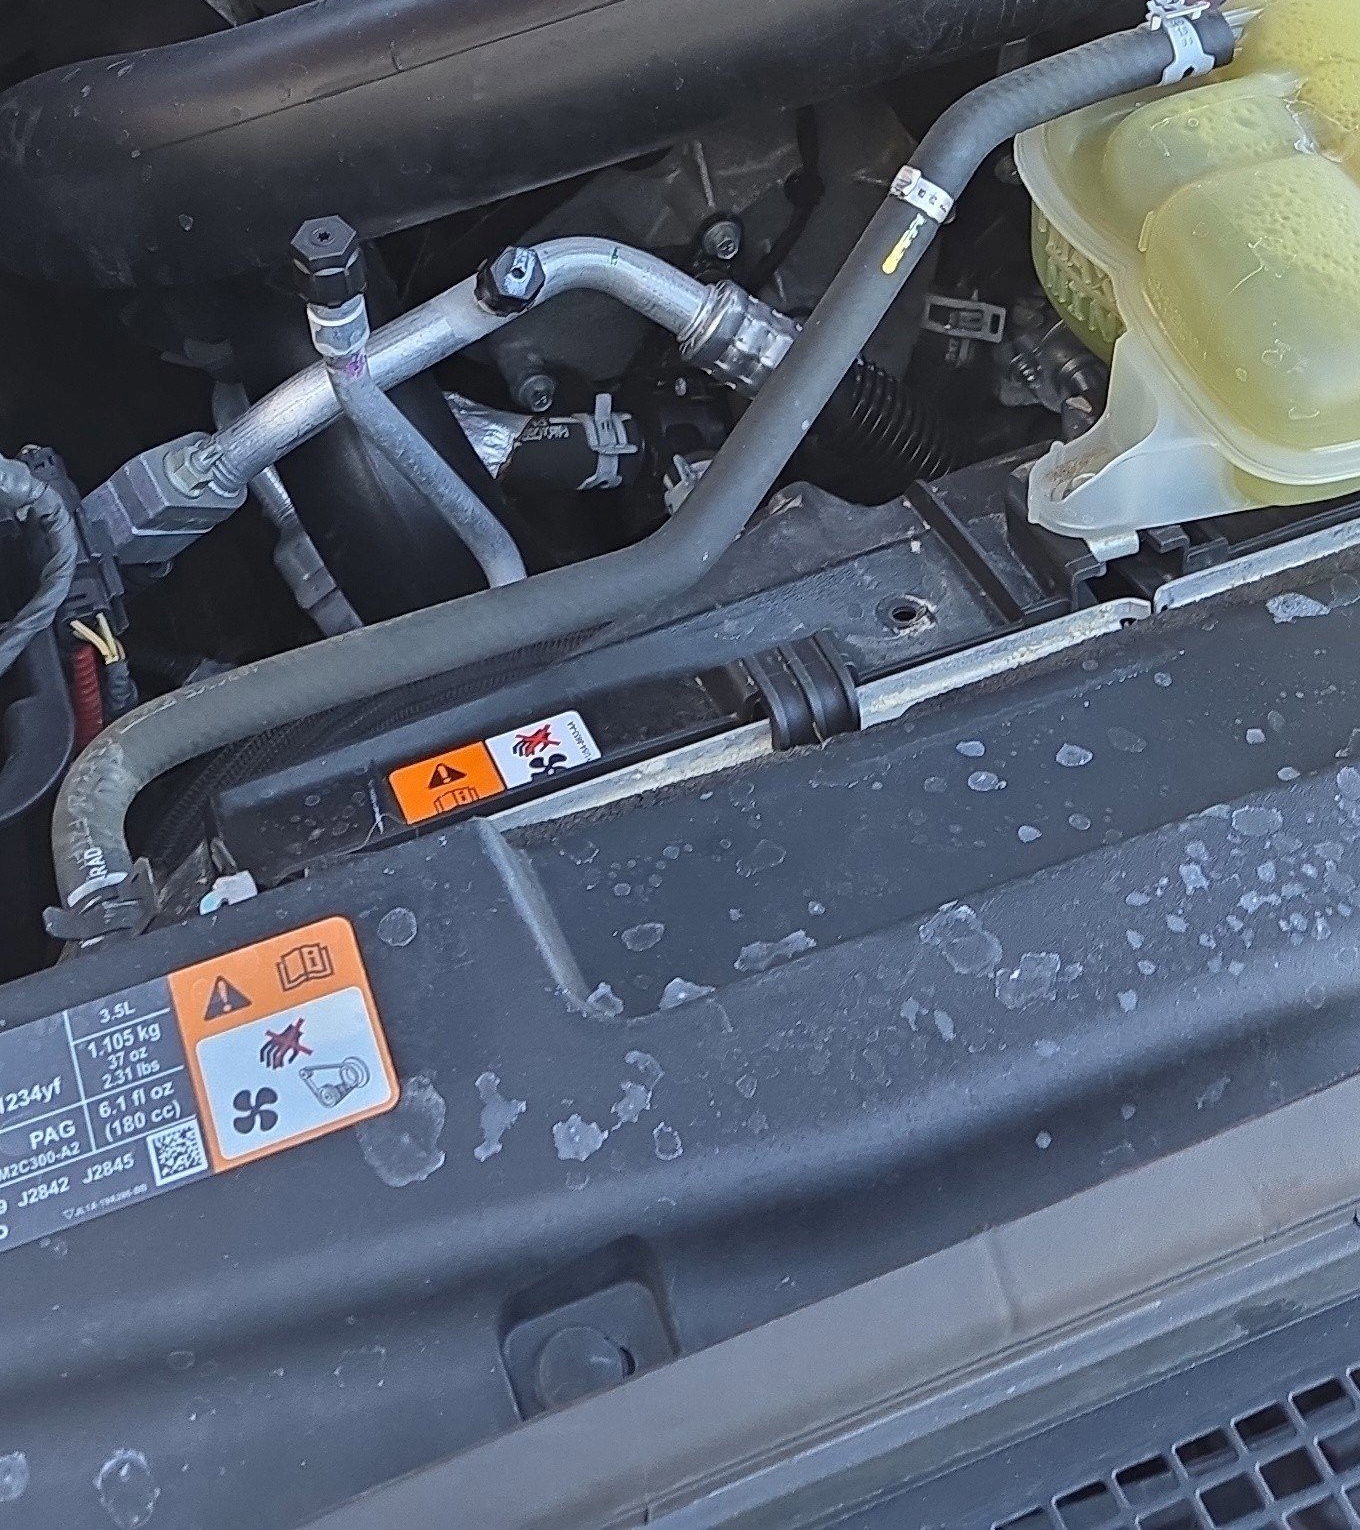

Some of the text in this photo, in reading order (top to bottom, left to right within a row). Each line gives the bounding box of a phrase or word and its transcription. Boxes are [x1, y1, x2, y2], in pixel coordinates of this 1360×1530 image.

[99, 1001, 136, 1023] 3.5L
[88, 1023, 161, 1058] 1.105 kg
[107, 1046, 148, 1070] 37 oz
[102, 1060, 160, 1090] 2.31 lbs
[98, 1081, 174, 1118] 6.1 fl oz
[29, 1120, 77, 1150] PAG
[105, 1099, 181, 1142] (180 cc)
[17, 1177, 71, 1208] J2842
[82, 1153, 135, 1185] J2845
